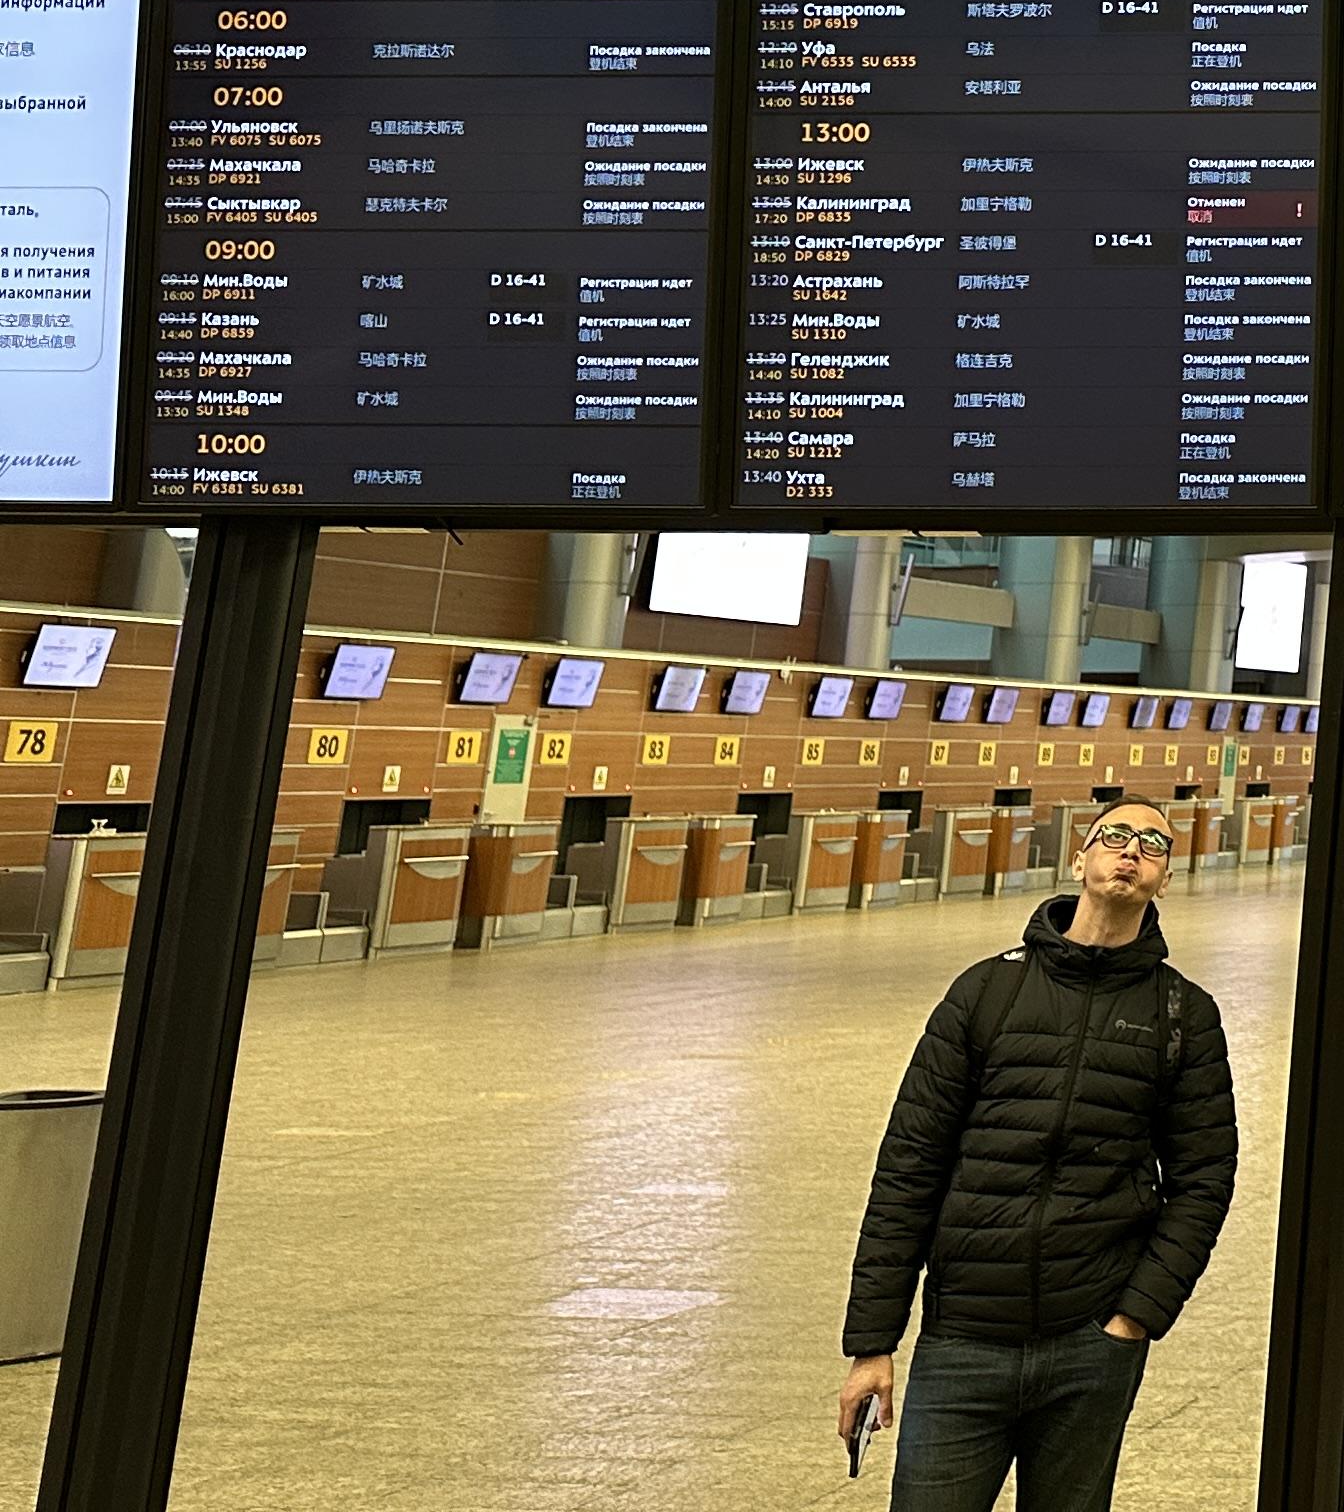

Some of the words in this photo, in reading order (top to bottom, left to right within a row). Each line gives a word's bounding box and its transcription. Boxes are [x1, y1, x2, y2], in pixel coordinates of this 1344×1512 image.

[218, 11, 287, 29] 06:00
[211, 120, 297, 133] Ульяновск
[803, 123, 870, 142] 13:00
[206, 241, 275, 260] 09:00
[795, 235, 944, 251] Санкт-Петербург
[14, 248, 94, 260] получения
[28, 268, 89, 278] питания
[491, 274, 501, 285] D
[506, 274, 545, 286] 16-41
[752, 275, 788, 286] 13:20
[204, 274, 287, 289] Мин.Воды
[581, 278, 659, 289] Регистрация
[662, 280, 693, 289] идет
[793, 275, 883, 291] Астрахань
[199, 434, 266, 454] 10:00
[194, 468, 258, 481] Ижевск
[786, 471, 824, 484] Ухта
[17, 730, 46, 755] 78
[317, 735, 339, 757] 80
[456, 737, 473, 757] 81
[548, 739, 564, 758] 82
[649, 741, 664, 759] 83
[720, 742, 733, 760] 84
[807, 744, 819, 760] 85
[864, 745, 875, 761] 86
[934, 746, 945, 761] 87
